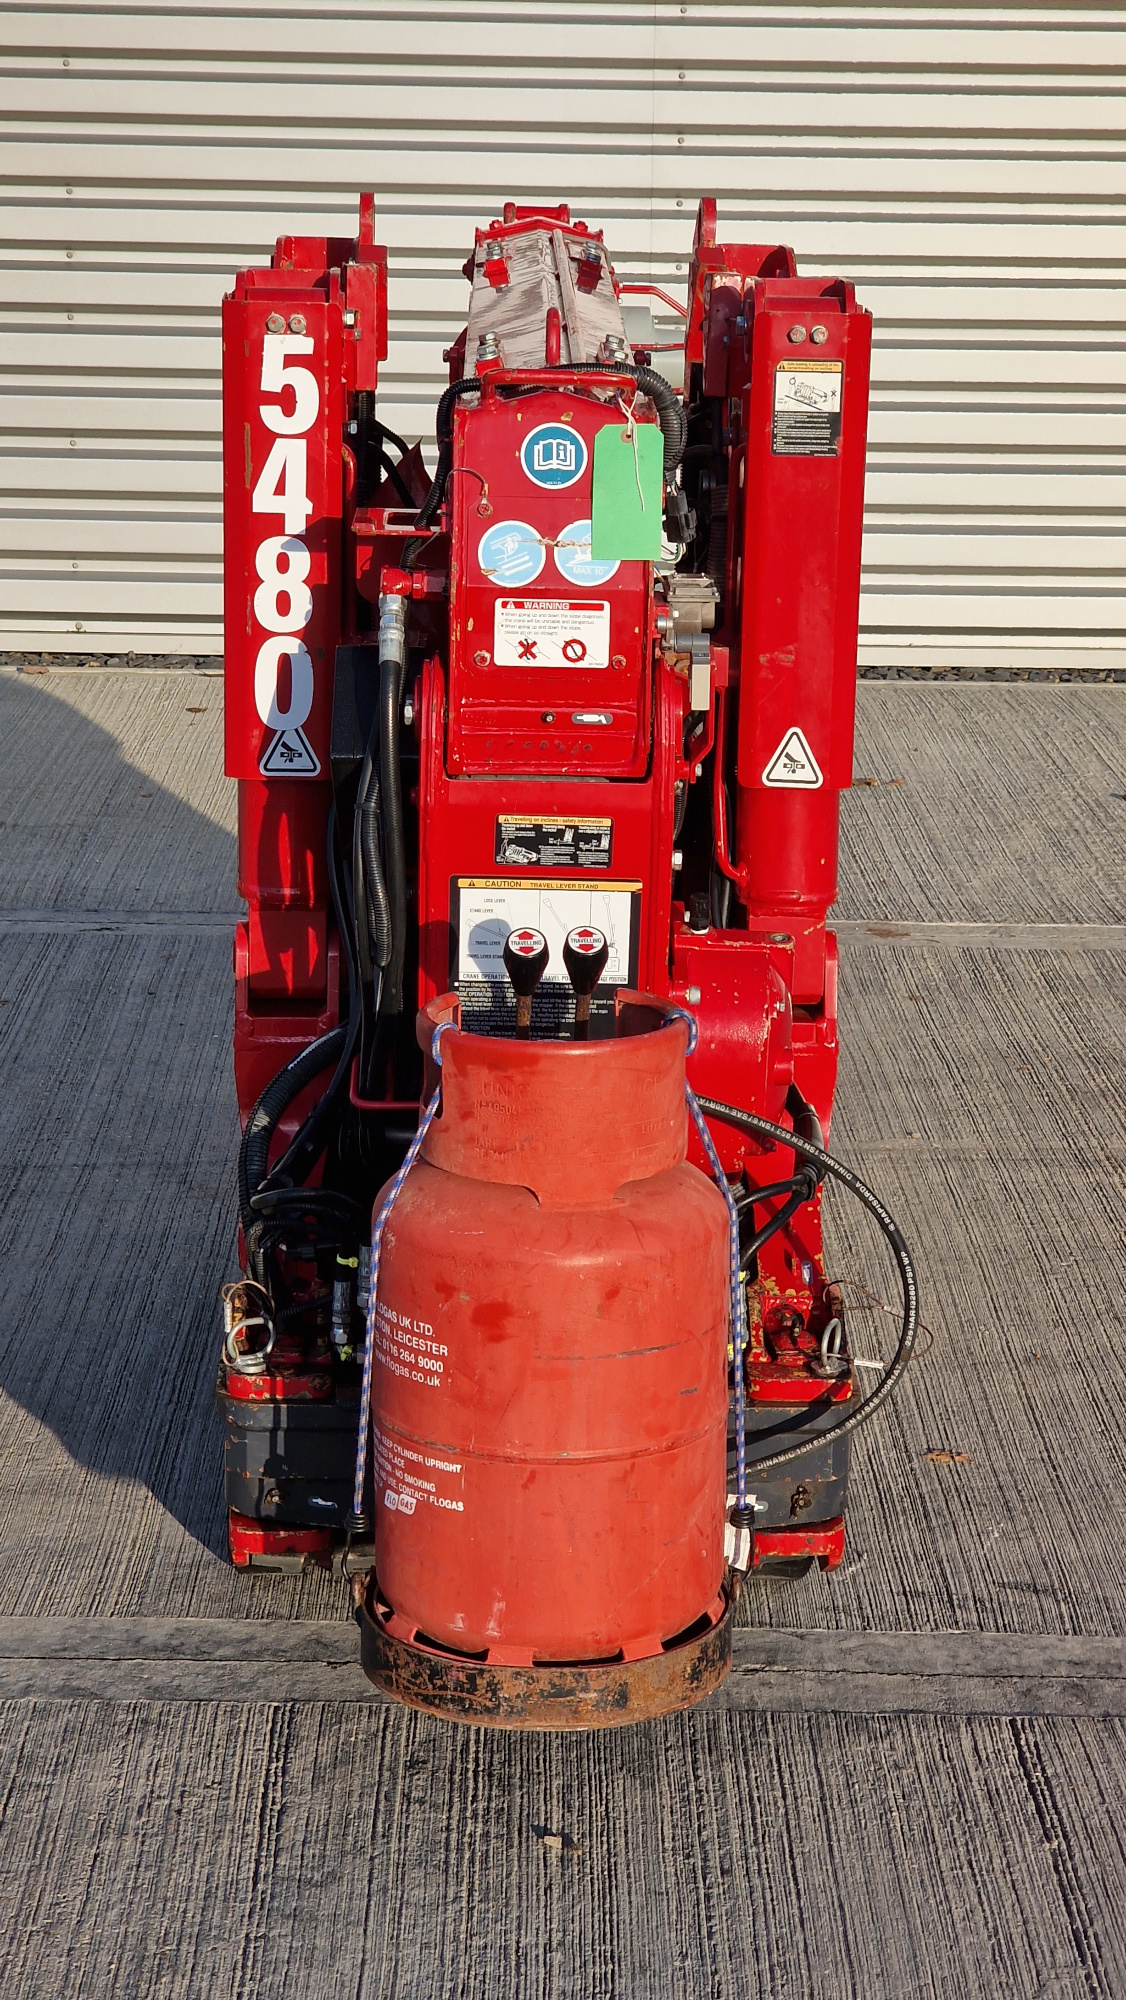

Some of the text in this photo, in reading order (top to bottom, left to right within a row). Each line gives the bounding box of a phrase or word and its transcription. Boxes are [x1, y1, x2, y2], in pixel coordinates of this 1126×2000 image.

[252, 334, 319, 731] 5480
[573, 567, 592, 575] MAX
[523, 601, 570, 610] WARNING
[791, 1135, 803, 1146] EN
[820, 1153, 853, 1180] DINAMIC
[856, 1181, 891, 1224] RAPISARDA
[377, 1299, 436, 1337] LOGAS UK LTD.
[382, 1338, 399, 1357] 0116
[399, 1348, 415, 1364] 264
[418, 1355, 444, 1373] 9000
[393, 1328, 448, 1356] LEICESTER
[757, 1452, 796, 1470] DINAMIC
[813, 1436, 826, 1447] EN
[900, 1251, 910, 1266] WP
[381, 1436, 462, 1473] KEEP CYLINDER UPRIGHT
[389, 1452, 406, 1469] PLACE
[395, 1468, 403, 1480] NO
[404, 1473, 436, 1493] SMOKING
[386, 1493, 415, 1512] FLO GAS
[398, 1483, 428, 1501] CONTACT
[429, 1495, 464, 1512] FLOGAS
